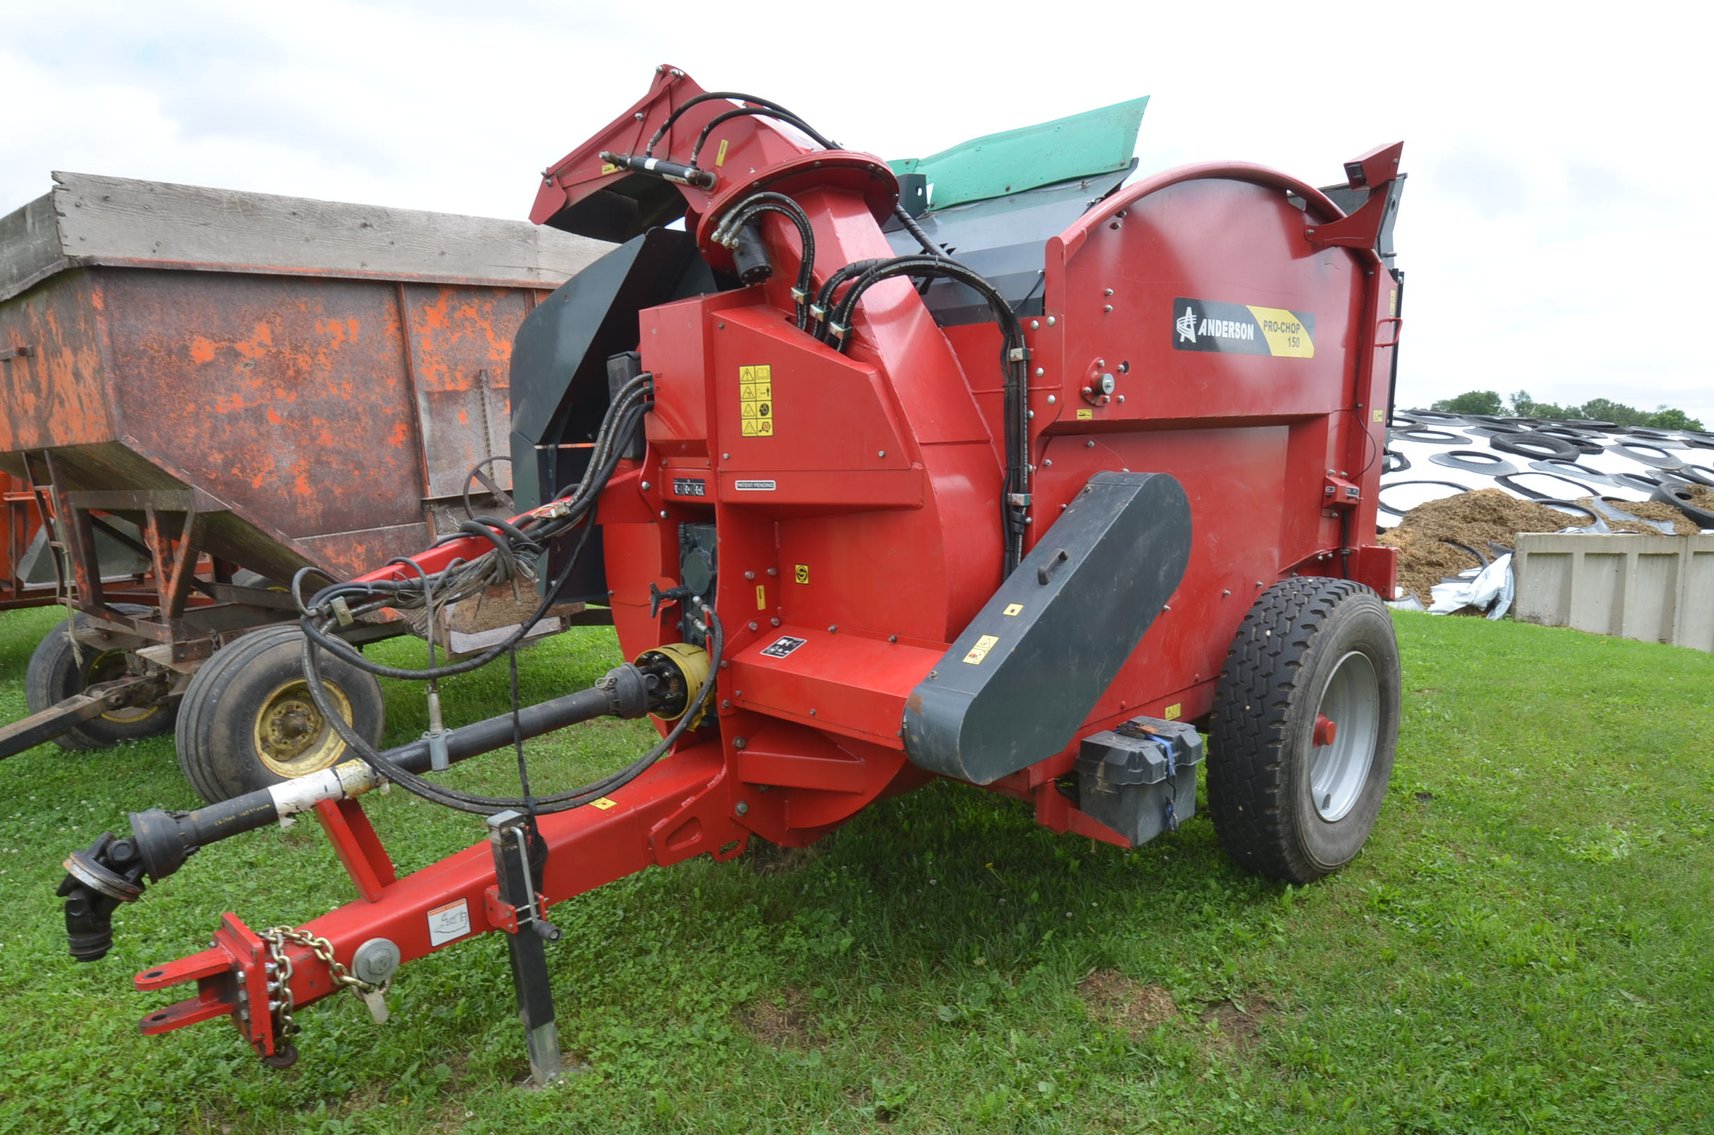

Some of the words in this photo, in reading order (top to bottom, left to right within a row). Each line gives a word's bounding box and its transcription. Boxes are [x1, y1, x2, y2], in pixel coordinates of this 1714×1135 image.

[1198, 319, 1254, 340] ANDERSON
[1263, 319, 1301, 334] PRO-CHOP
[1287, 336, 1300, 348] 150
